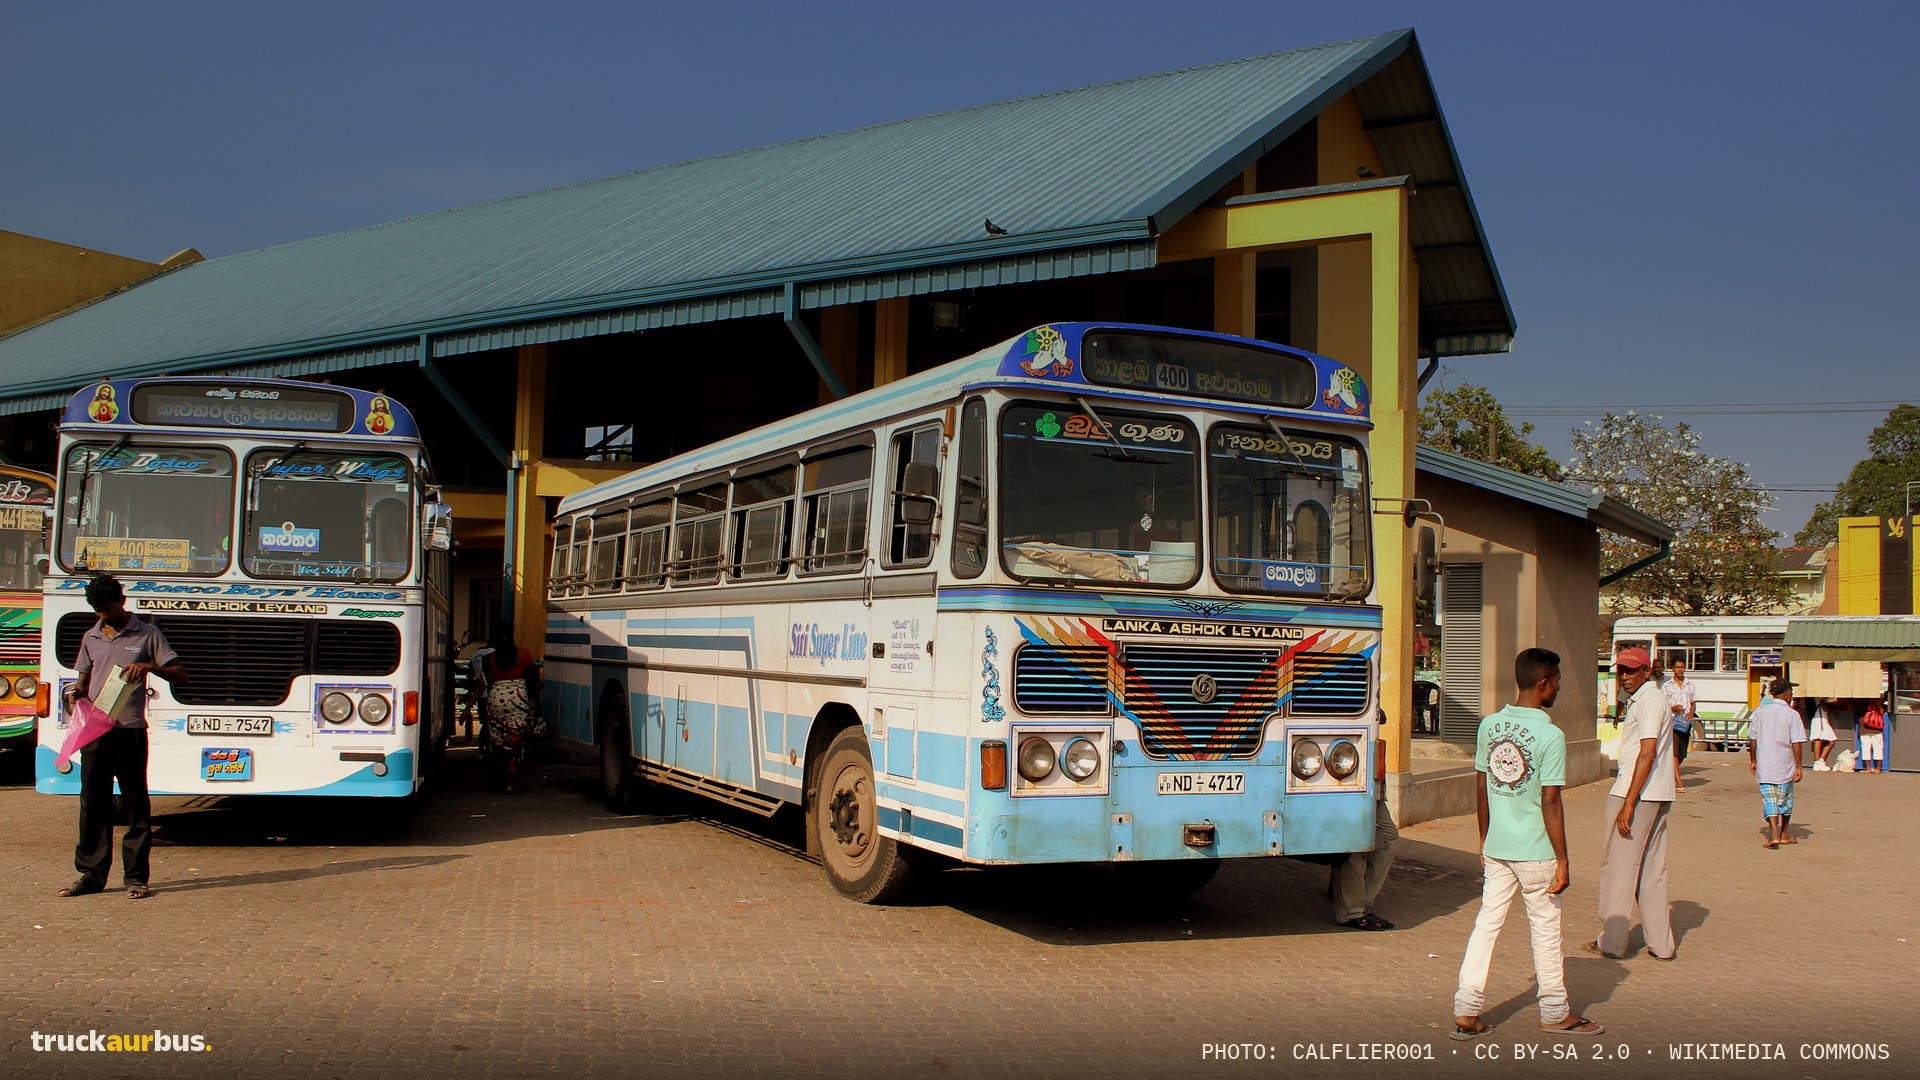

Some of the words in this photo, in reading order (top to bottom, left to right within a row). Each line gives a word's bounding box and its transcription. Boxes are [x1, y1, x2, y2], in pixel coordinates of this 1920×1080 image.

[1158, 365, 1187, 389] 400
[225, 414, 249, 424] 400
[1119, 423, 1185, 443] ගුණ
[131, 453, 209, 469] Bosco
[335, 460, 405, 480] Wings
[262, 531, 317, 548] කළුතර
[120, 541, 144, 559] 400
[1266, 565, 1316, 587] කොළඹ
[128, 581, 222, 595] Bosco
[307, 587, 401, 600] Home
[137, 600, 190, 610] LANKA
[197, 602, 250, 612] ASHOK
[256, 602, 327, 613] LEYLAND
[1103, 619, 1162, 633] LANKA
[1168, 623, 1227, 636] ASHOK
[1232, 625, 1304, 639] LEYLAND
[790, 623, 810, 658] Siri
[809, 623, 840, 667] Super
[841, 622, 868, 660] Line
[203, 718, 221, 731] ND
[236, 719, 270, 732] 7547
[1488, 722, 1536, 745] COPPER
[1160, 783, 1171, 792] WP
[1173, 775, 1192, 792] ND
[1208, 775, 1243, 791] 4717
